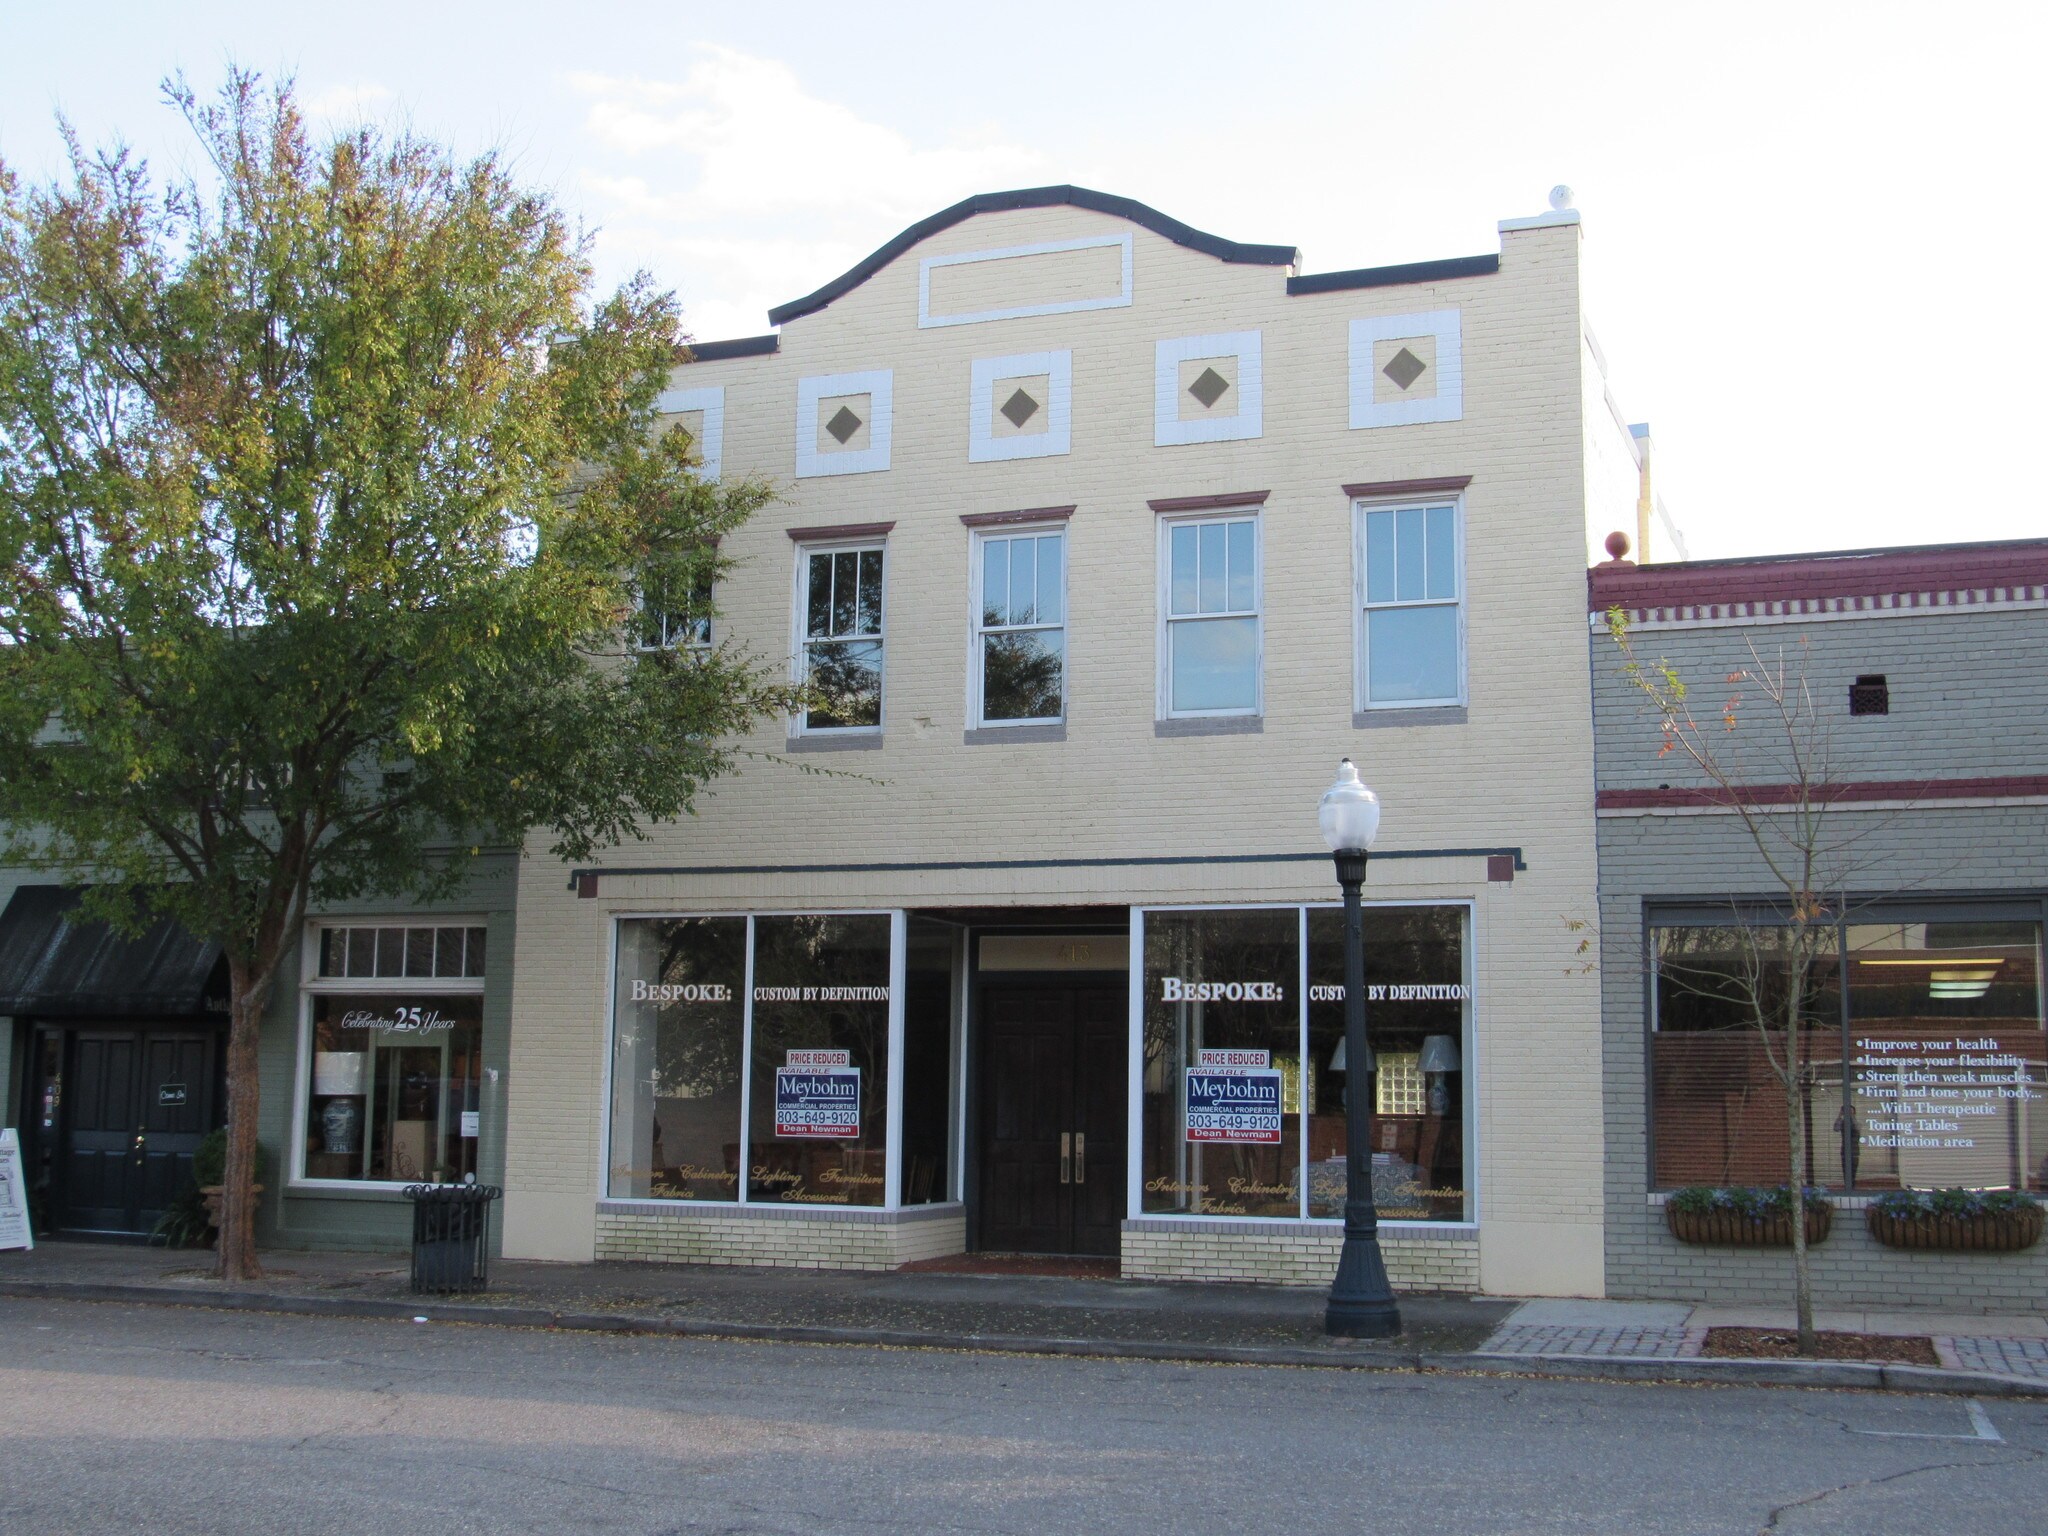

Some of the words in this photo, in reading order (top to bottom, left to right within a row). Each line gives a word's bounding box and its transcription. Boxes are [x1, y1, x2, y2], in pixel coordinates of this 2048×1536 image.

[631, 979, 732, 1001] BESPOKE:
[754, 987, 800, 1000] CUSTOM
[803, 987, 818, 1000] BY
[820, 986, 889, 1000] DEFINITION
[1161, 977, 1283, 1001] BESPOKE:
[1309, 985, 1346, 1001] CUST
[1368, 985, 1387, 1000] BY
[1389, 984, 1470, 1000] DEFINITION
[341, 1010, 409, 1035] Celebrating
[395, 1007, 421, 1029] 25
[420, 1010, 456, 1036] Years
[1864, 1038, 1918, 1053] Improve
[1921, 1041, 1952, 1053] your
[1956, 1038, 1998, 1050] health
[790, 1053, 811, 1065] PRICE
[813, 1053, 846, 1065] REDUCED
[1201, 1052, 1226, 1065] PRICE
[1227, 1053, 1265, 1065] REDUCED
[1864, 1055, 1920, 1066] Increase
[1925, 1057, 1954, 1069] your
[1959, 1054, 2026, 1069] flexibility
[1188, 1068, 1247, 1076] AVAILABLE
[1865, 1070, 1938, 1085] Strengthen
[1943, 1071, 1976, 1082] weak
[1980, 1071, 2032, 1082] muscles
[781, 1076, 855, 1103] Meybohm
[1191, 1077, 1276, 1106] Meybohm
[1866, 1086, 1897, 1097] Firm
[1902, 1086, 1927, 1098] and
[1931, 1088, 1959, 1098] tone
[1963, 1089, 1993, 1101] your
[778, 1102, 818, 1110] COMMERCIAL
[1189, 1105, 1234, 1114] COMMERCIAL
[1235, 1106, 1278, 1114] PROPERTIES
[1914, 1102, 1996, 1117] Therapeutic
[777, 1111, 858, 1124] 803-649-9120
[1188, 1114, 1279, 1130] 803-649-9120
[811, 1125, 851, 1133] Newman
[1194, 1129, 1222, 1138] Dean
[1226, 1130, 1272, 1139] Newman
[1866, 1119, 1913, 1134] Toning
[1916, 1119, 1958, 1131] Tables
[1868, 1136, 1940, 1147] Meditation
[1944, 1137, 1974, 1147] area
[680, 1164, 738, 1186] Cabinetry
[751, 1165, 802, 1186] Lighting
[819, 1168, 884, 1184] Furniture
[649, 1182, 695, 1198] Fabrics
[782, 1186, 849, 1203] Accessories
[1227, 1176, 1297, 1200] Cabinetry
[1190, 1197, 1247, 1214] Fabrics
[1375, 1206, 1430, 1218] ccessories
